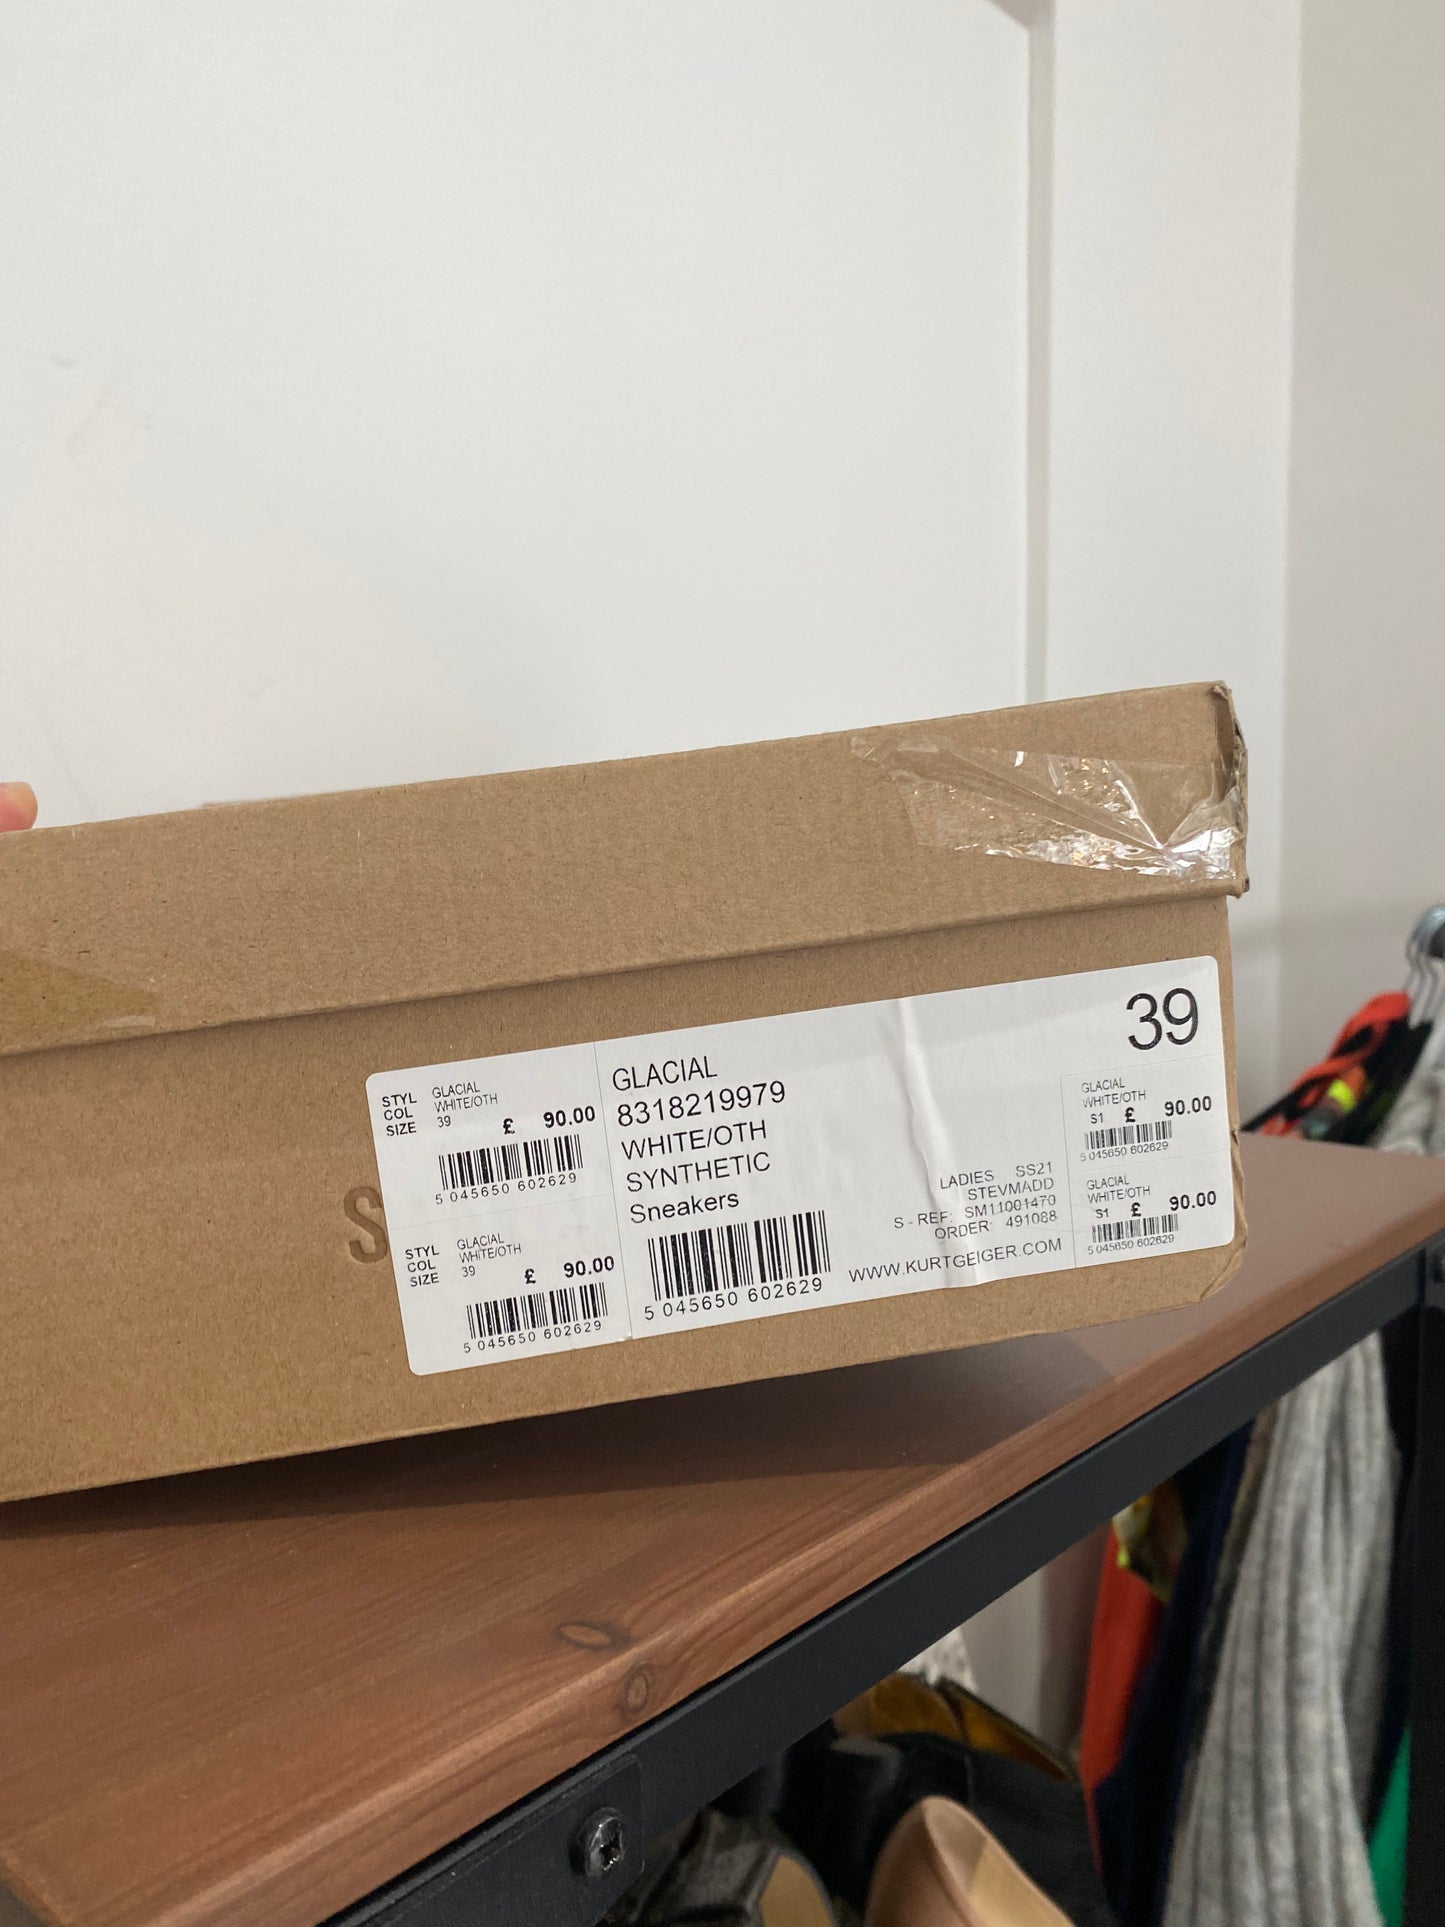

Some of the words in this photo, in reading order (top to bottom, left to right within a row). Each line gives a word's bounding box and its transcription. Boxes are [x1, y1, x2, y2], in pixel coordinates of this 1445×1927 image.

[1126, 987, 1199, 1051] 39
[612, 1056, 718, 1091] GLACIAL
[1081, 1077, 1126, 1093] GLACIAL
[381, 1092, 418, 1108] STYL
[432, 1081, 481, 1099] GLACIAL
[383, 1106, 413, 1121] COL
[434, 1093, 498, 1113] WHITE/OTH
[617, 1080, 786, 1127] 8318219979
[1082, 1089, 1147, 1108] WHITE/OTH
[1090, 1113, 1104, 1124] S1
[1124, 1107, 1136, 1123] £
[1164, 1095, 1212, 1117] 90.00
[386, 1121, 417, 1137] SIZE
[436, 1115, 451, 1128] 39
[502, 1118, 516, 1135] £
[543, 1105, 596, 1128] 90.00
[621, 1119, 767, 1160] WHITE/OTH
[626, 1151, 771, 1192] SYNTHETIC
[939, 1169, 995, 1190] LADIES
[1015, 1161, 1053, 1178] SS21
[1086, 1175, 1130, 1190] GLACIAL
[435, 1193, 443, 1205] 5
[450, 1183, 510, 1202] 045650
[517, 1172, 577, 1191] 602629
[968, 1177, 1054, 1201] STEVMADD
[1087, 1186, 1151, 1204] WHITE/OTH
[630, 1192, 740, 1224] Sneakers
[1095, 1208, 1109, 1219] S1
[1130, 1202, 1142, 1217] £
[1169, 1190, 1217, 1211] 90.00
[934, 1219, 993, 1240] ORDER:
[1006, 1209, 1058, 1228] 491088
[405, 1245, 440, 1260] STYL
[456, 1233, 504, 1250] GLACIAL
[407, 1258, 436, 1273] COL
[459, 1243, 522, 1263] WHITE/OTH
[848, 1237, 1062, 1283] WWW.KURTGEIGER.COM
[410, 1272, 440, 1287] SIZE
[462, 1265, 476, 1278] 39
[524, 1268, 536, 1284] £
[563, 1255, 615, 1278] 90.00
[644, 1305, 655, 1320] 5
[662, 1291, 738, 1317] 045650
[748, 1277, 823, 1303] 602629
[463, 1342, 471, 1353] 5
[477, 1331, 536, 1351] 045650
[543, 1320, 602, 1340] 602629
